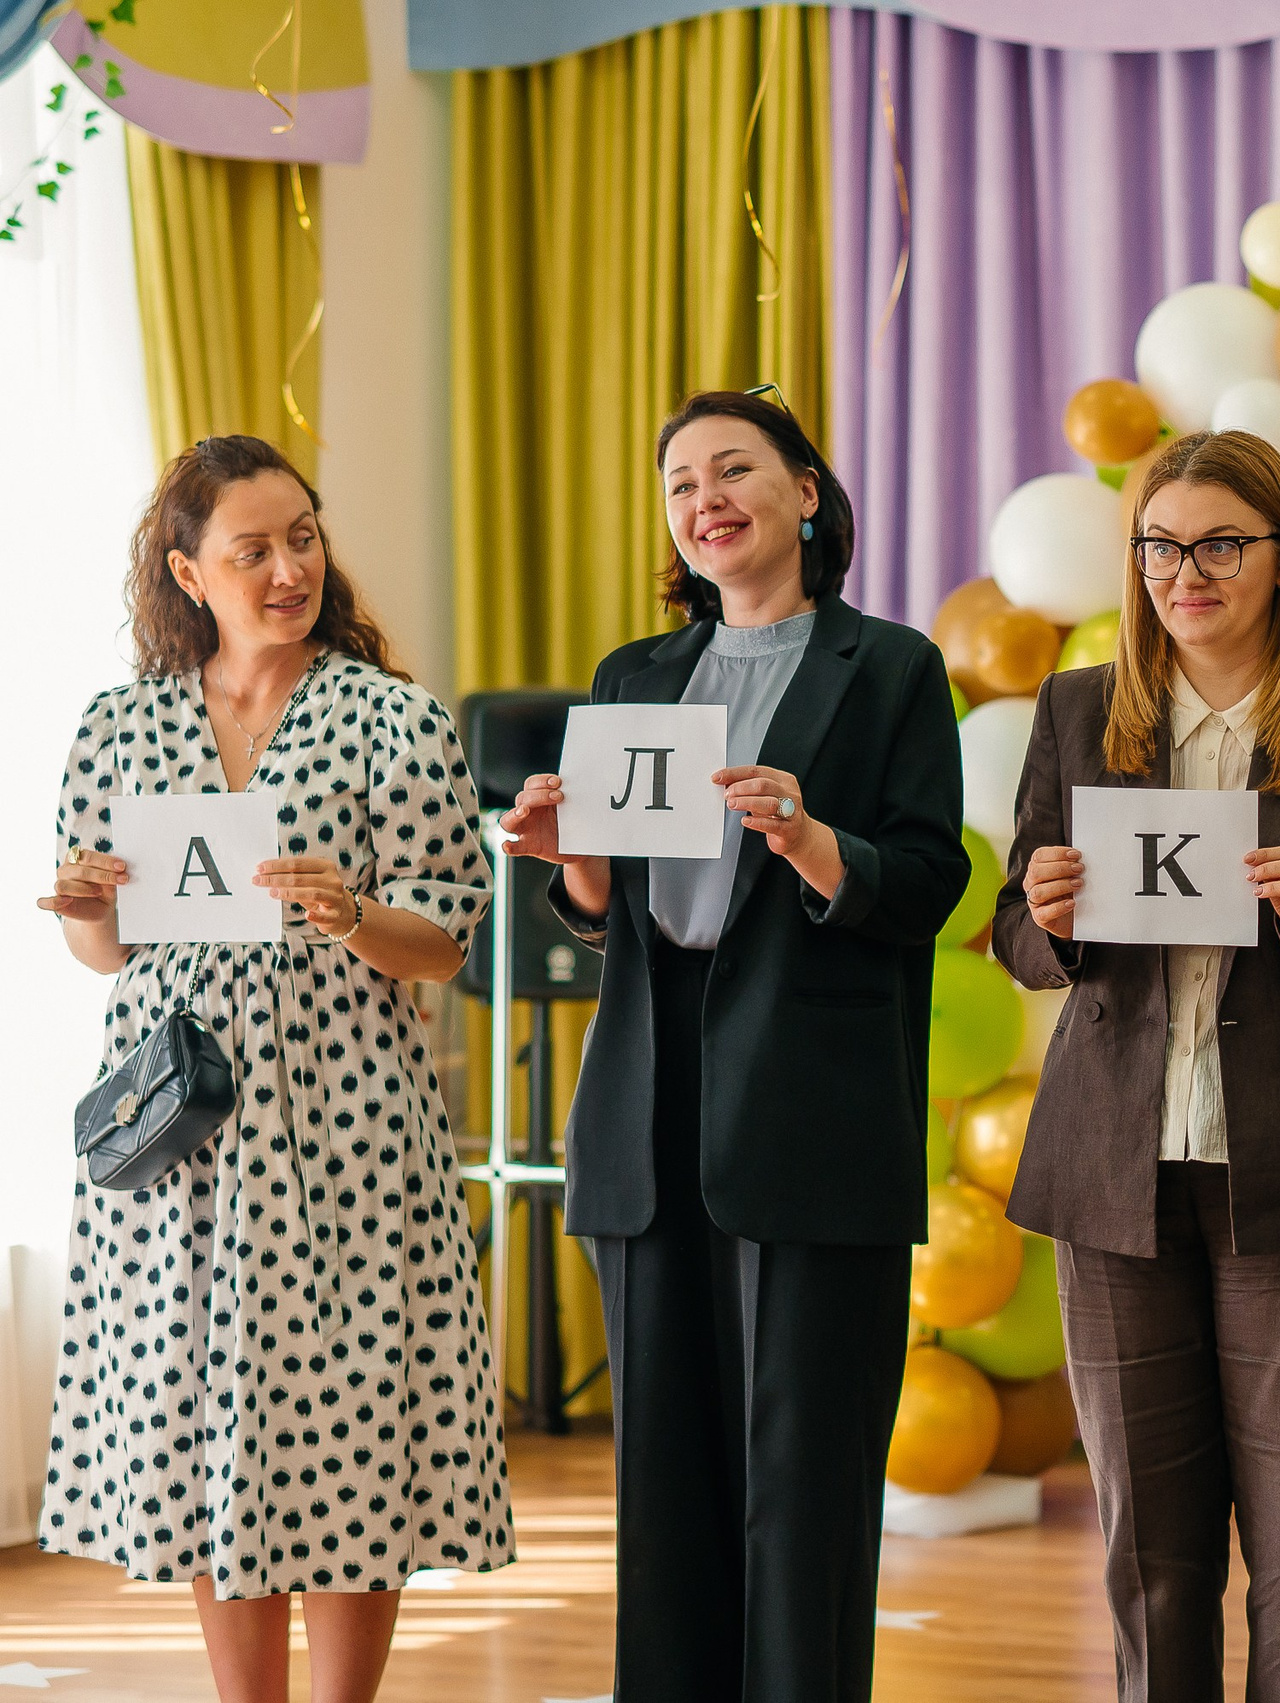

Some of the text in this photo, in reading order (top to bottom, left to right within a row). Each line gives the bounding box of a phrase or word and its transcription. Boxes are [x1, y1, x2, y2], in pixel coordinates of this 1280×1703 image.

[610, 747, 675, 811] Л
[174, 837, 232, 896] А
[1135, 833, 1202, 897] К
